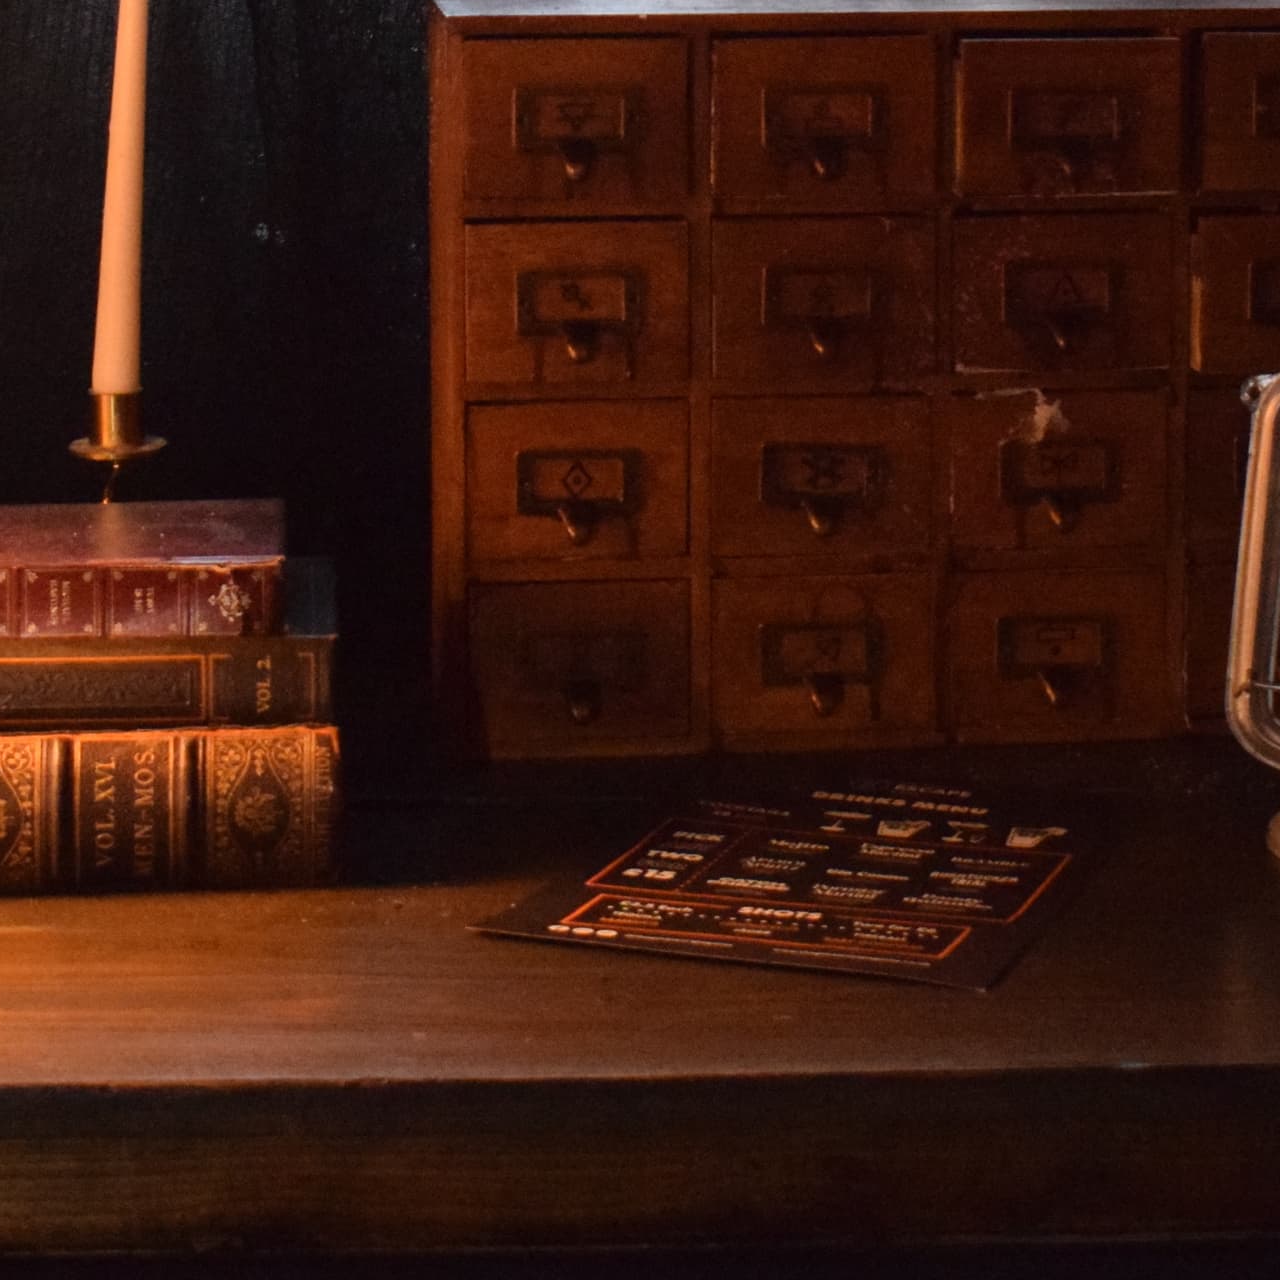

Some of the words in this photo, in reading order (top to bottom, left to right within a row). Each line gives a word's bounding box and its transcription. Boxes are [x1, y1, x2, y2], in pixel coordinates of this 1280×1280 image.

[811, 791, 907, 805] DRINKS
[911, 801, 989, 814] MENU
[94, 808, 116, 867] VOL.
[647, 849, 705, 862] TWO
[736, 906, 824, 920] SHOTS
